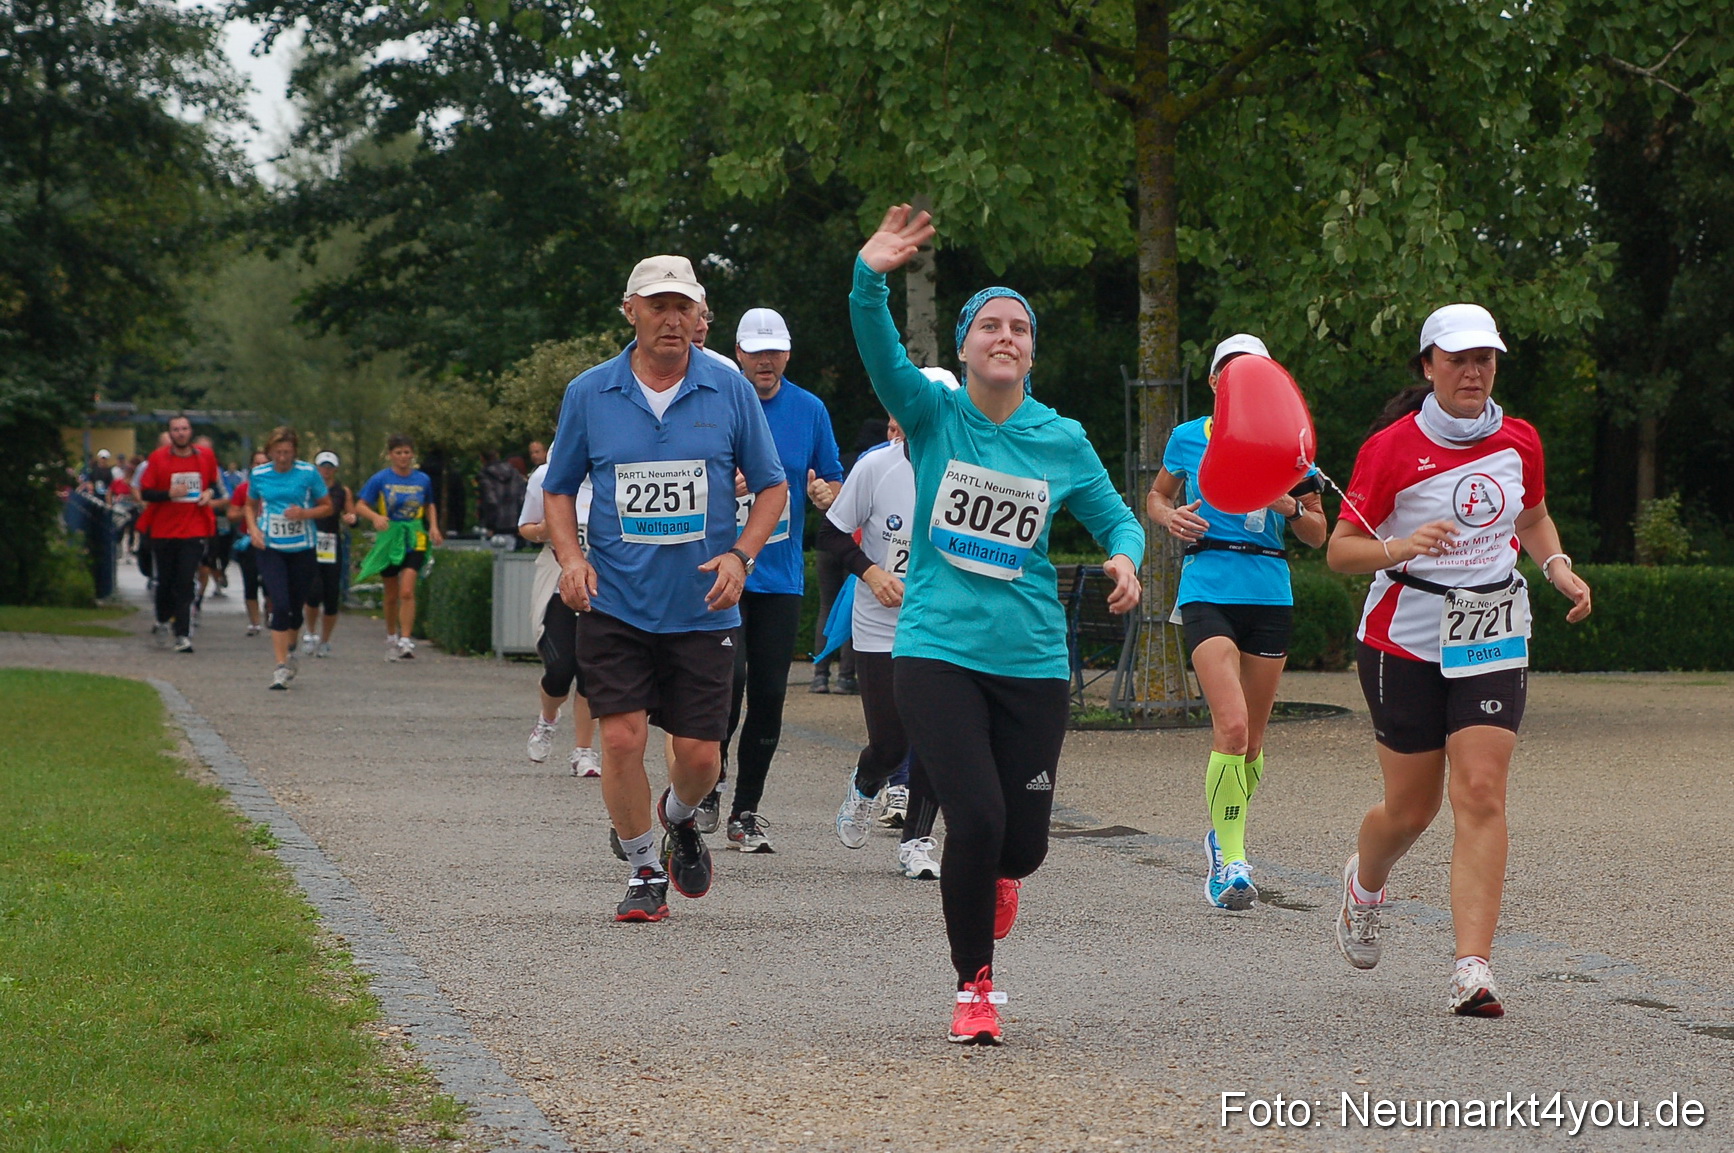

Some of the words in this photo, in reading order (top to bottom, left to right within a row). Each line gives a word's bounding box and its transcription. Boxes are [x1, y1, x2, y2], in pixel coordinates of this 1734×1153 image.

[618, 471, 646, 480] PARTL
[648, 470, 691, 479] Neumarkt
[946, 470, 981, 488] PARTL
[984, 481, 1035, 500] Neumarkt
[626, 481, 695, 513] 2251
[635, 521, 690, 535] Wolfgang
[944, 489, 1040, 543] 3026
[948, 536, 1018, 566] Katharina
[1473, 535, 1491, 545] MIT
[1447, 599, 1514, 641] 2727
[1467, 647, 1502, 662] Petra
